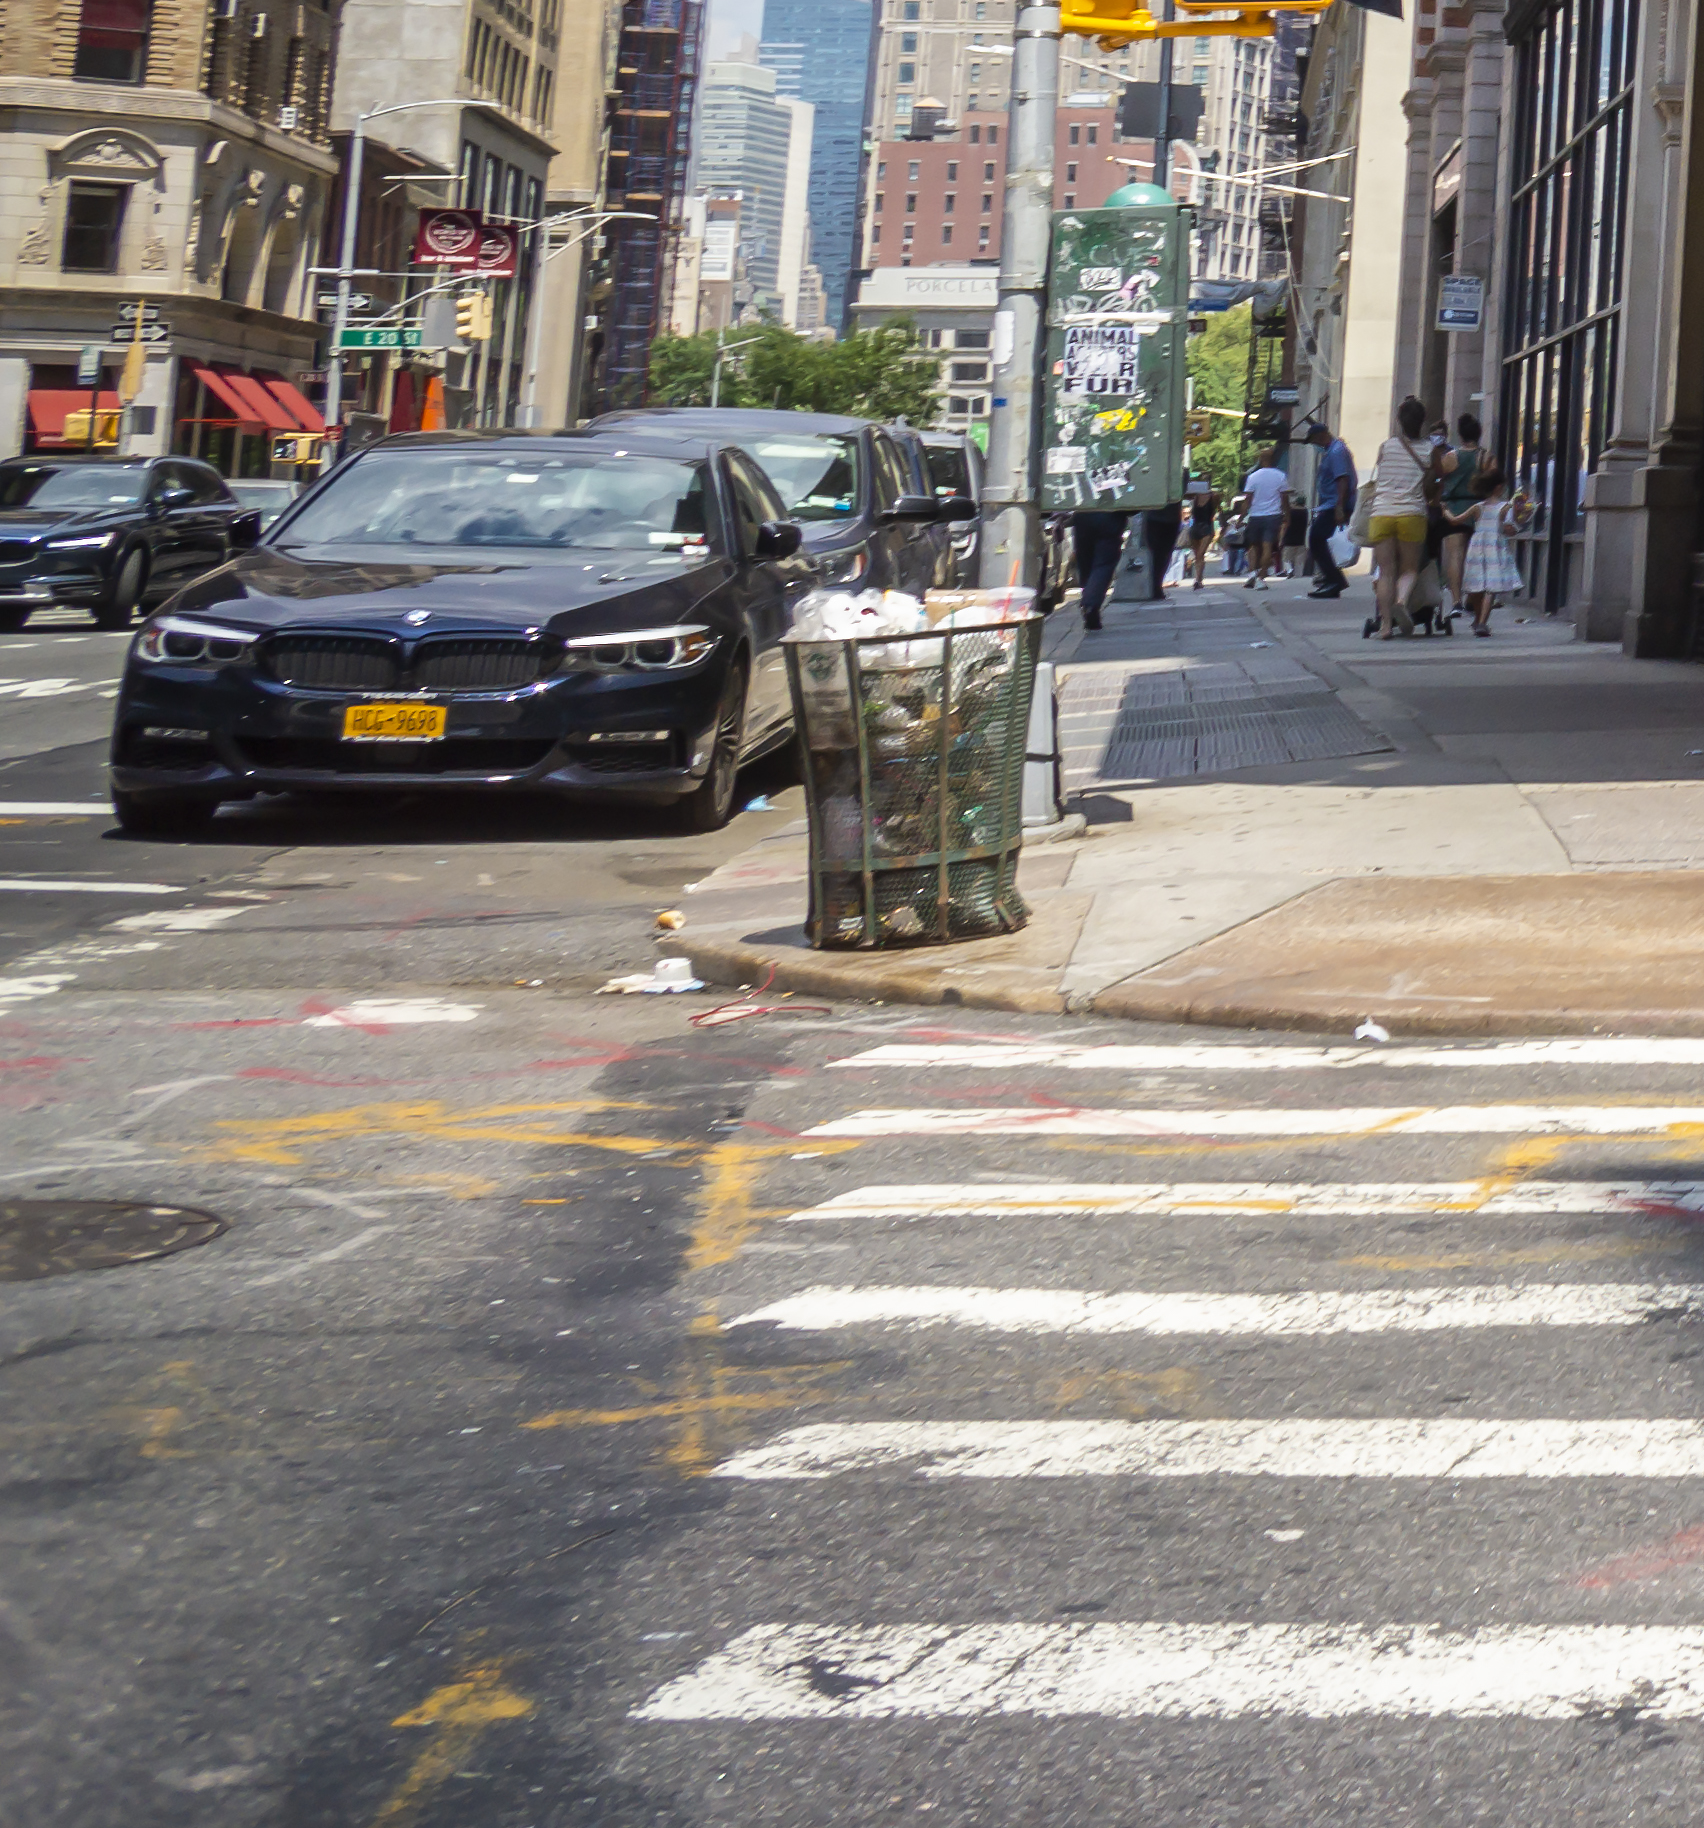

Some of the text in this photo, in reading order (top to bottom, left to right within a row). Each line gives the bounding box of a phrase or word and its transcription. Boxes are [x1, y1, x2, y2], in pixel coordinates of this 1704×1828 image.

[906, 279, 996, 293] PORCELA
[363, 332, 374, 345] E
[377, 332, 399, 345] 20
[1067, 329, 1140, 345] ANIMAL
[1063, 377, 1134, 394] FUR
